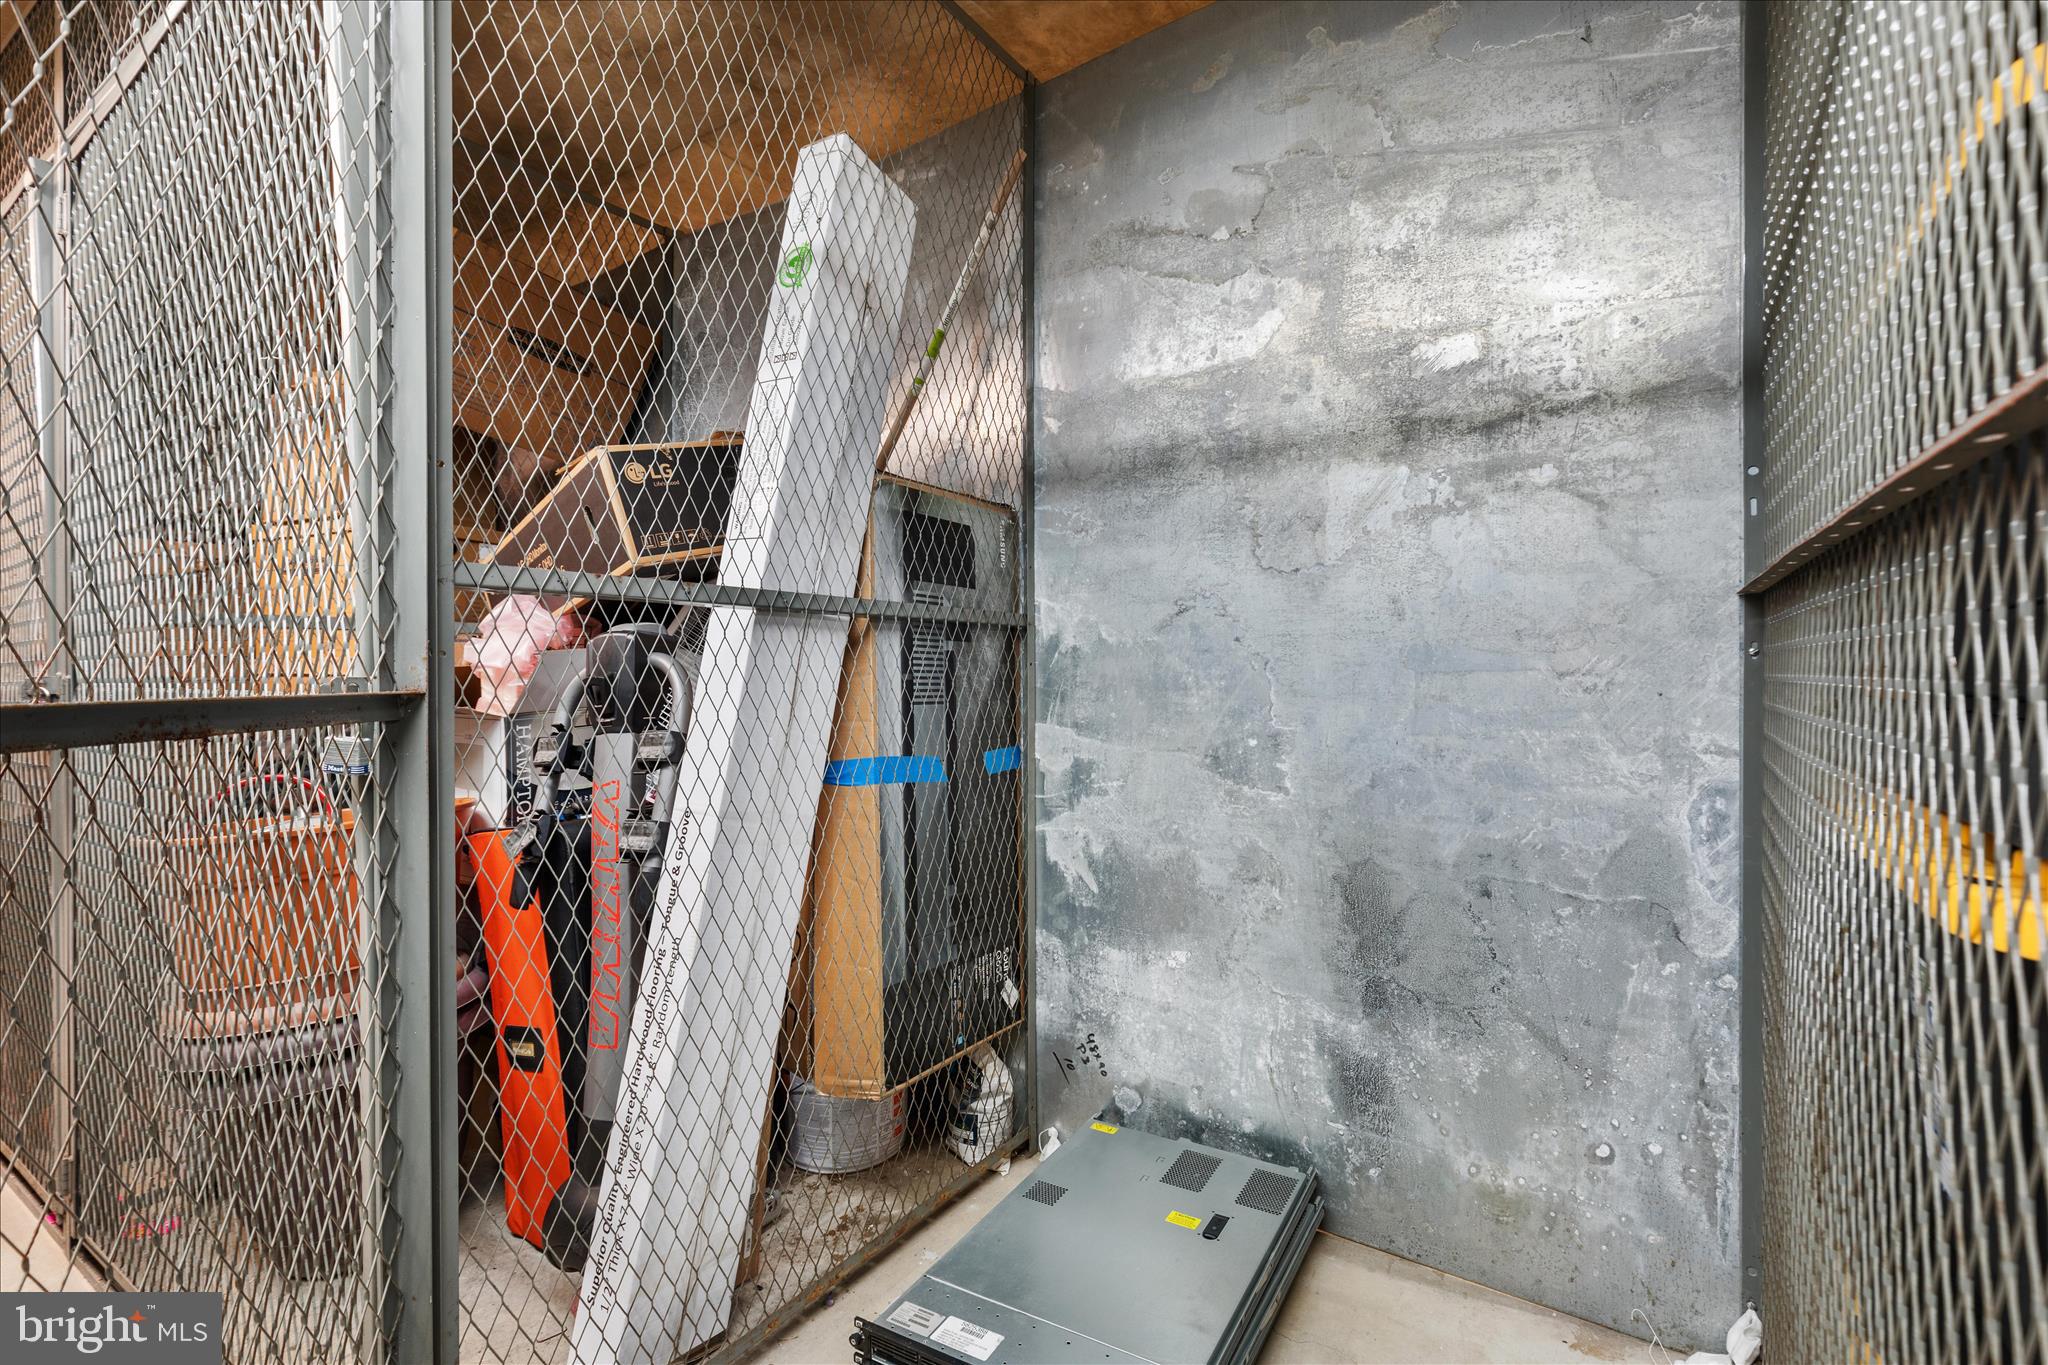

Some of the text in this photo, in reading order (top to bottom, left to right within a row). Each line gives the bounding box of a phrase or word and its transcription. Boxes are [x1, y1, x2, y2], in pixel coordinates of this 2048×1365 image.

[648, 463, 673, 478] LG
[675, 810, 691, 860] Groove
[672, 865, 680, 876] &
[662, 879, 679, 931] Tongue
[648, 949, 666, 1007] Flooring
[631, 1010, 653, 1088] Hardwood
[608, 1235, 623, 1273] Thick
[627, 1141, 642, 1179] Wide
[653, 988, 671, 1048] Random
[666, 937, 681, 984] Length
[615, 1090, 638, 1174] Engineered
[603, 1181, 619, 1233] Quality
[587, 1236, 609, 1305] Superior
